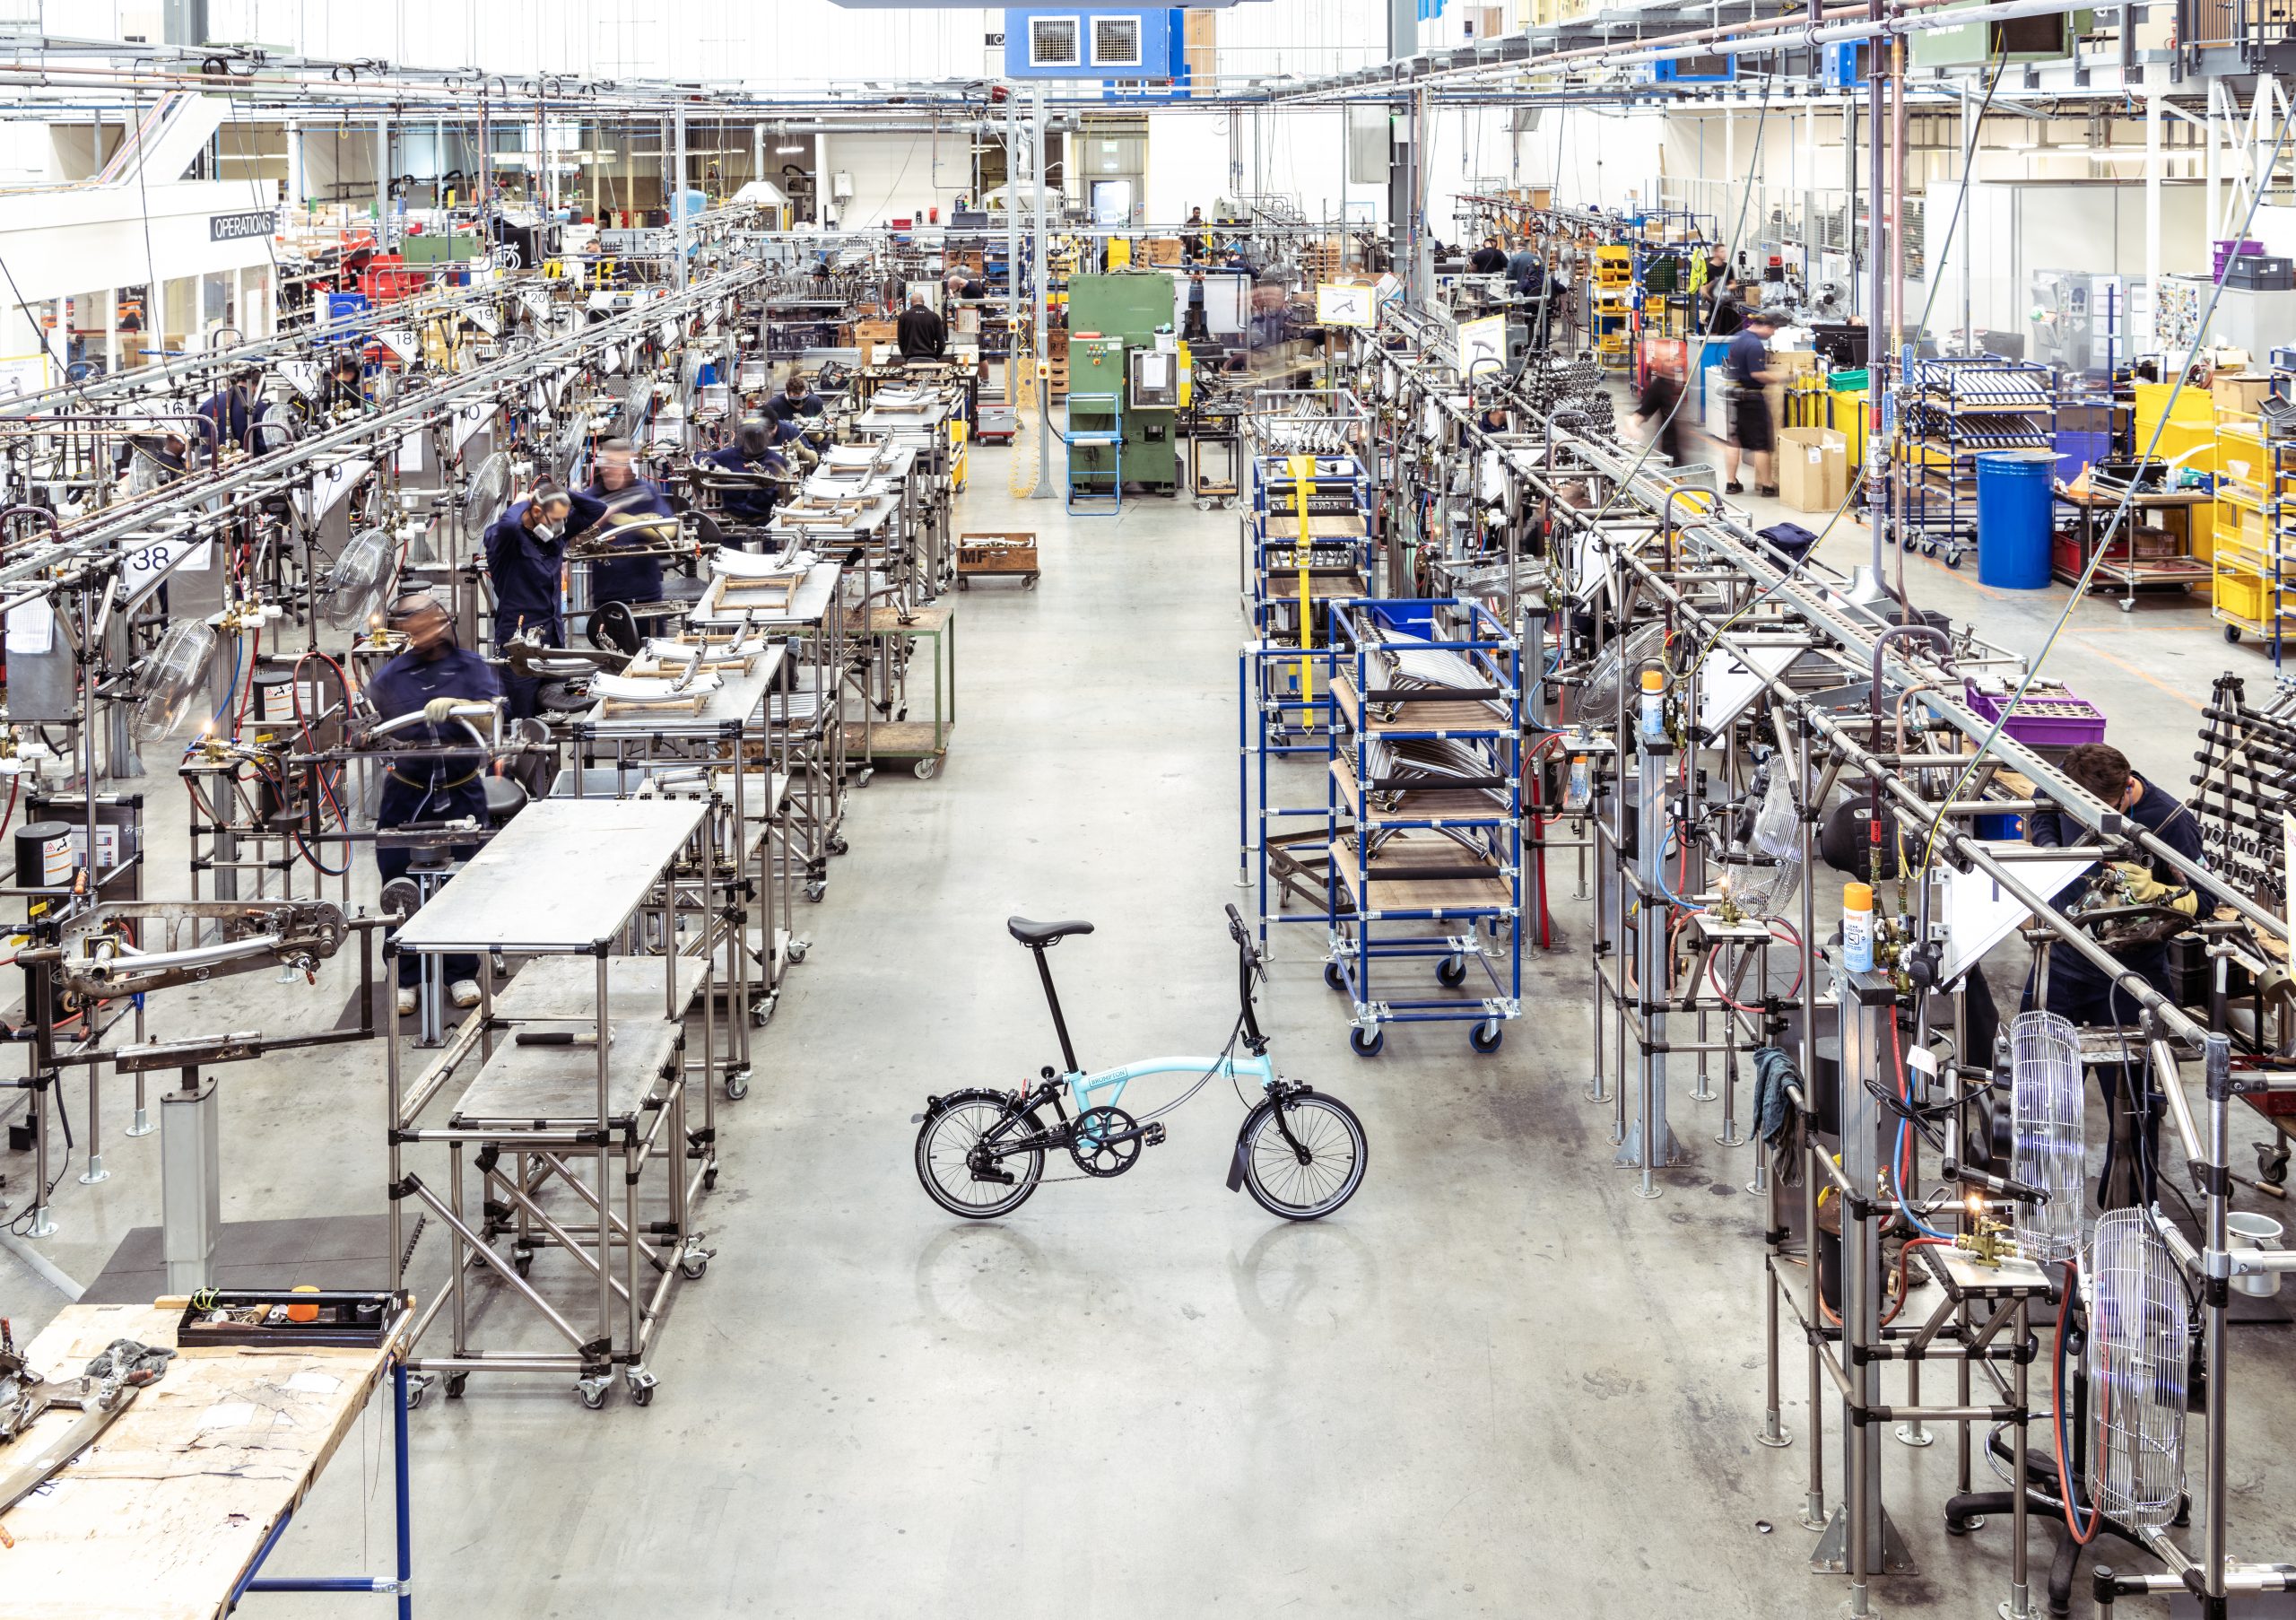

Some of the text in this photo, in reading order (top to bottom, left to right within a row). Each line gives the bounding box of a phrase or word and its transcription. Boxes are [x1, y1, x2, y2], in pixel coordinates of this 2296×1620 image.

[214, 213, 271, 240] OPERATIONS
[531, 292, 545, 303] 20
[478, 309, 492, 321] 19
[395, 333, 412, 345] 18
[292, 363, 311, 378] 17
[162, 401, 185, 415] 16
[133, 546, 170, 571] 38
[960, 550, 988, 563] MF
[1845, 926, 1864, 934] DETECTOR
[1091, 1069, 1125, 1085] BROMPTON
